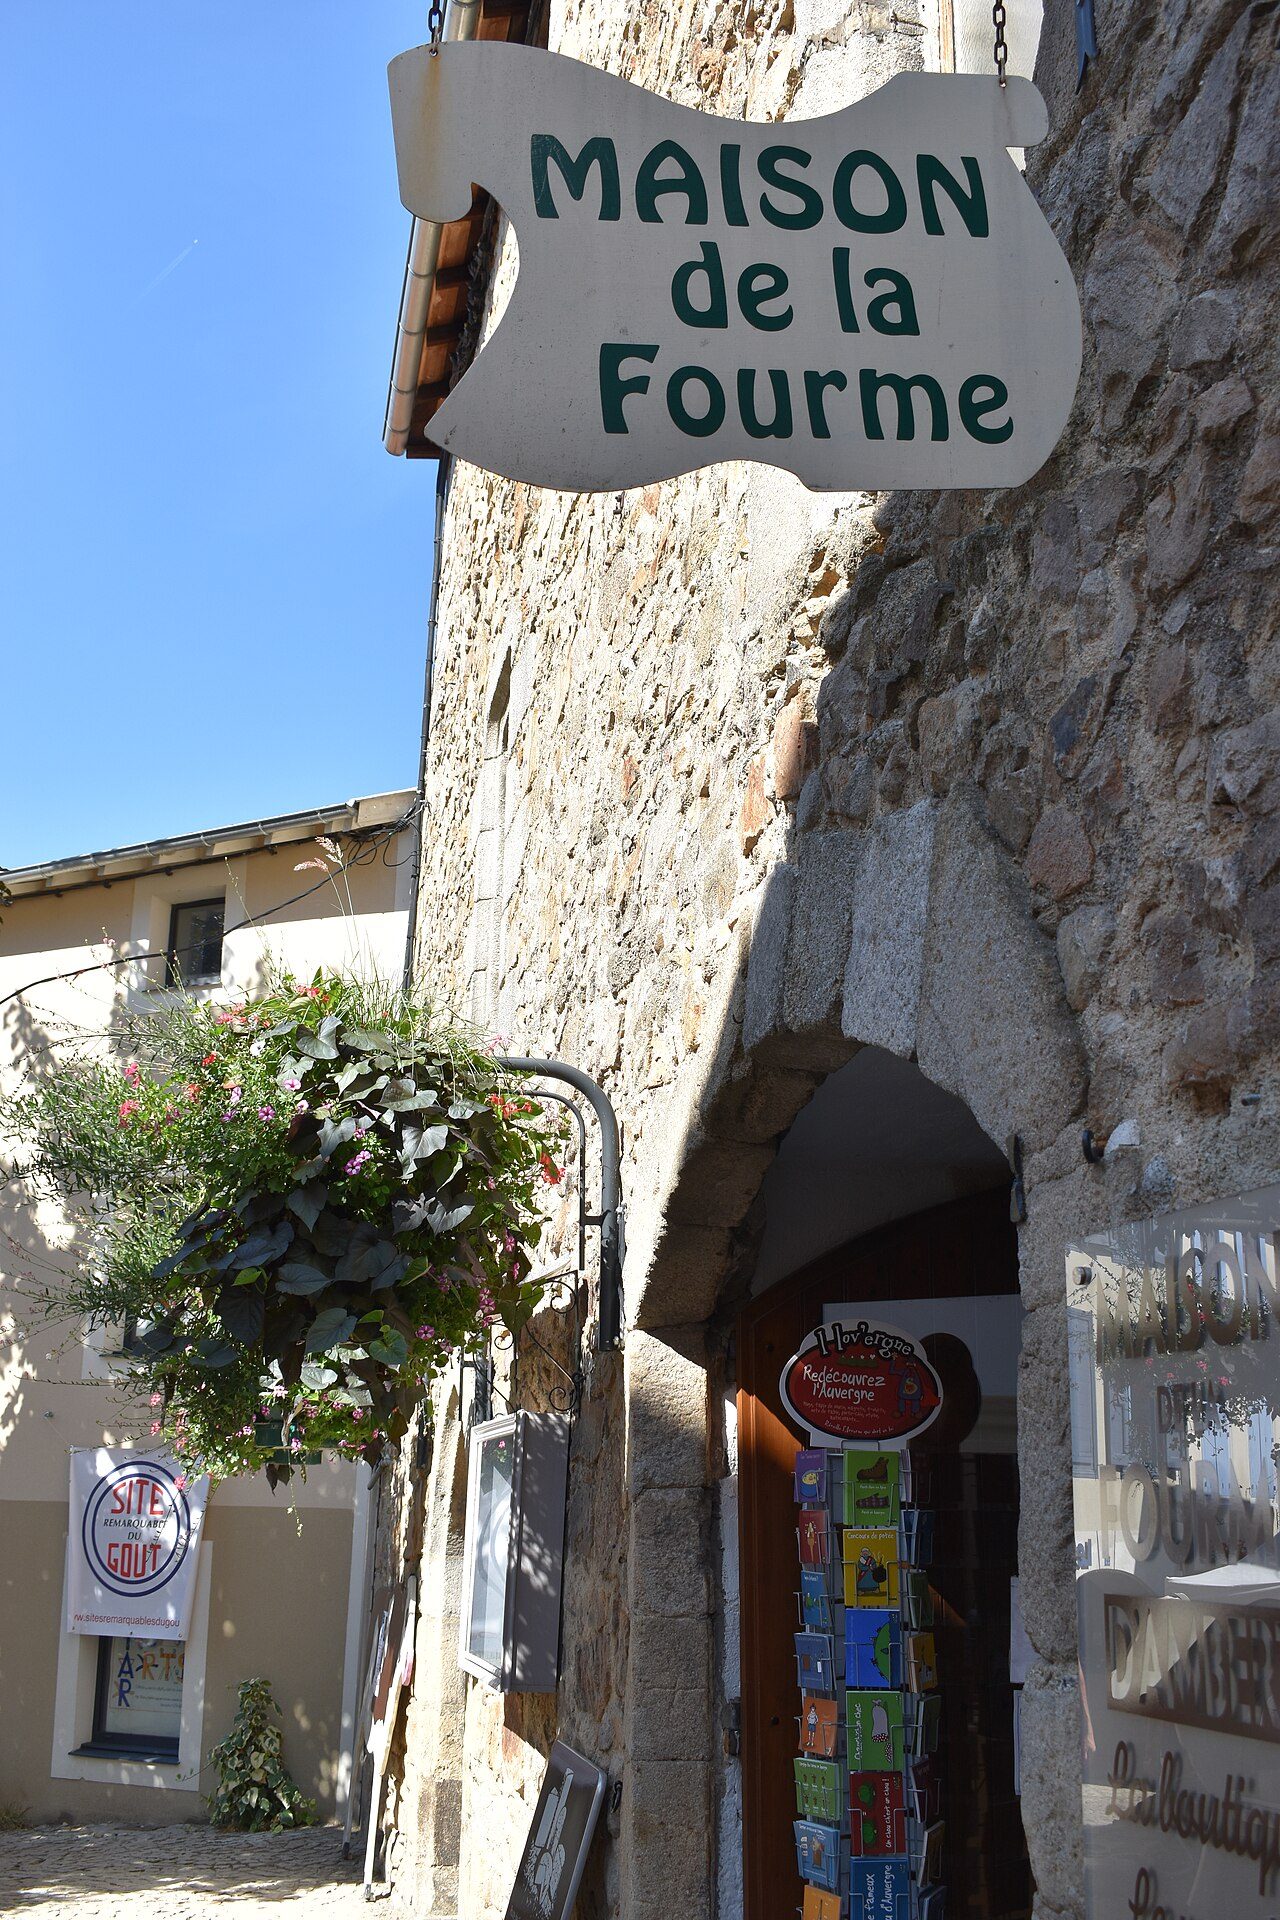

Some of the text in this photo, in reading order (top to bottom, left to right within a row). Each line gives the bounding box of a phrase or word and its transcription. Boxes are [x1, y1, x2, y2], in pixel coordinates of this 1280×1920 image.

[530, 133, 990, 238] MAISON
[671, 241, 921, 336] de la
[600, 342, 1014, 444] Fourme
[803, 1364, 886, 1387] Redécouvrez
[813, 1382, 875, 1404] l'Auvergne
[111, 1479, 164, 1515] SITE
[1099, 1457, 1277, 1566] FOURM
[127, 1531, 141, 1541] DU
[107, 1542, 161, 1578] GOUT
[1110, 1604, 1280, 1732] D'AMBER
[864, 1873, 875, 1911] fameux
[880, 1864, 895, 1912] d'Auvergne
